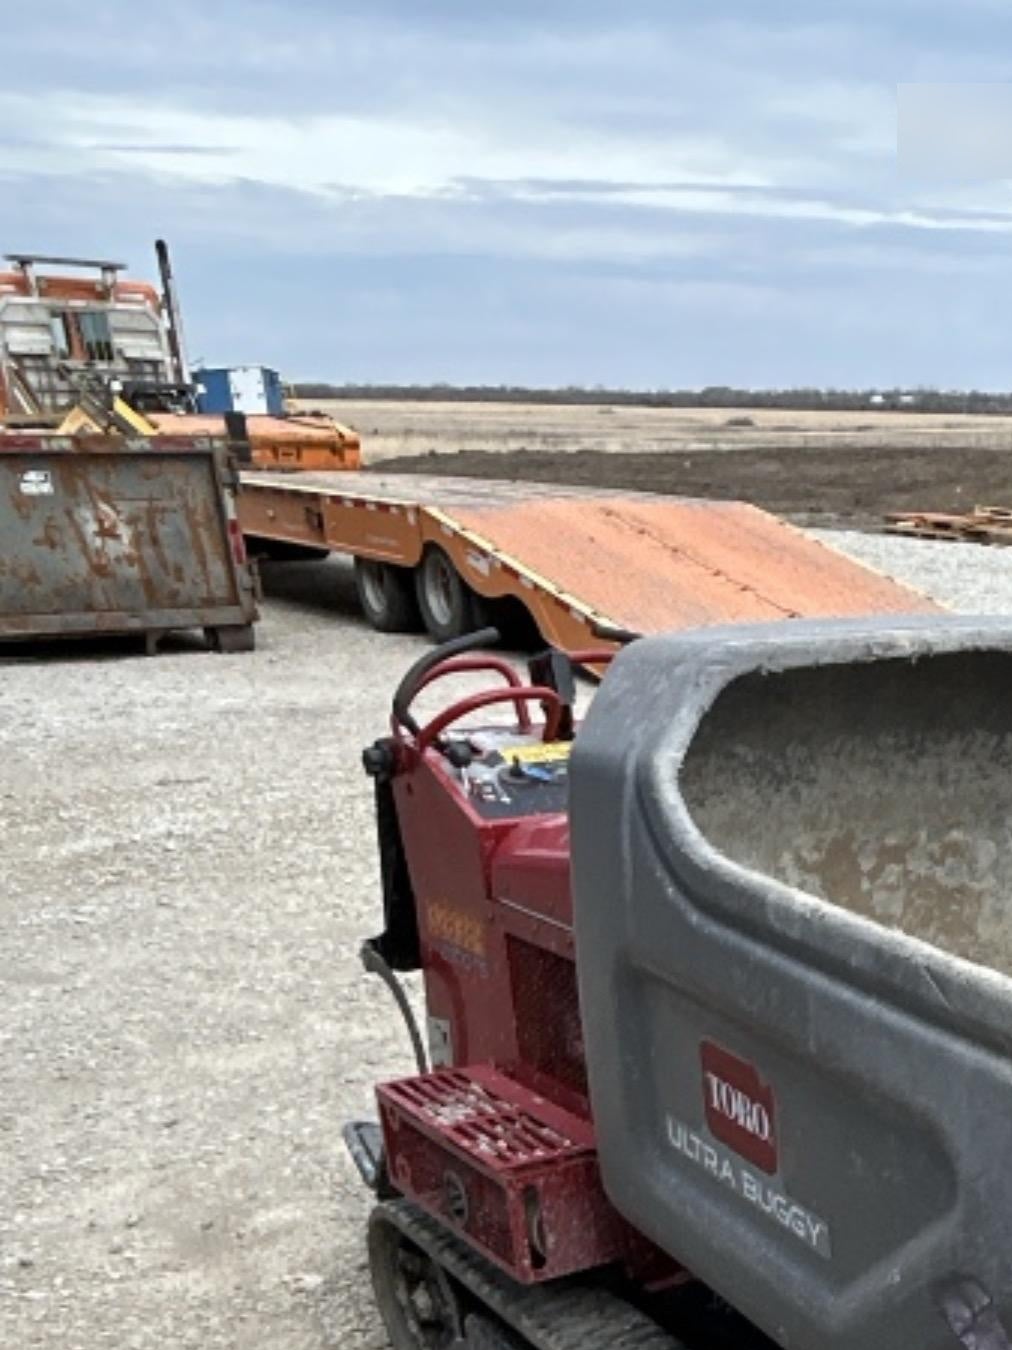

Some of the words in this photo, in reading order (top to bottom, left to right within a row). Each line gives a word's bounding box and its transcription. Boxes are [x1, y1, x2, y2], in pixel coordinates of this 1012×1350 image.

[705, 1071, 770, 1141] TORO
[666, 1114, 736, 1188] ULTRA
[742, 1170, 821, 1247] BUGGY
